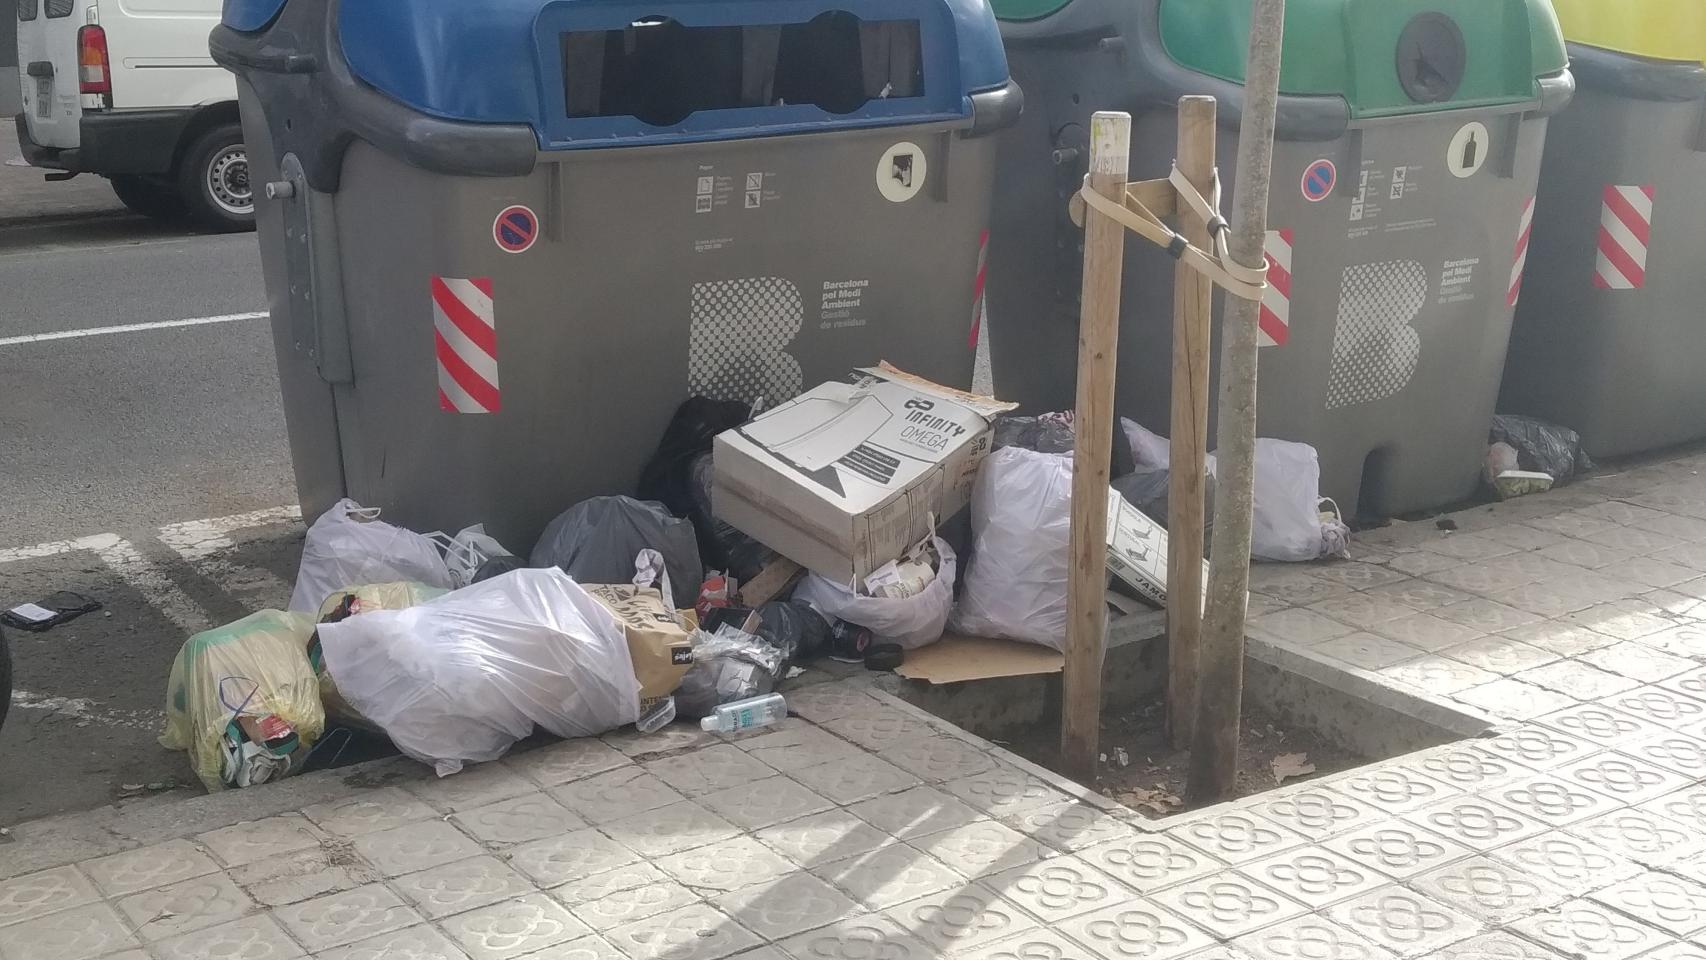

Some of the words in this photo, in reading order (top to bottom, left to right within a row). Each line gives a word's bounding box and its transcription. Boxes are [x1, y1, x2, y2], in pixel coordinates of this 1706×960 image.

[1443, 258, 1480, 268] Barcelona
[823, 279, 869, 290] Barcelona
[822, 290, 837, 301] pel
[838, 288, 861, 298] Medi
[821, 298, 861, 309] Ambient
[905, 410, 966, 438] INFINITY
[900, 425, 949, 451] OMEGA
[599, 585, 617, 605] TACO
